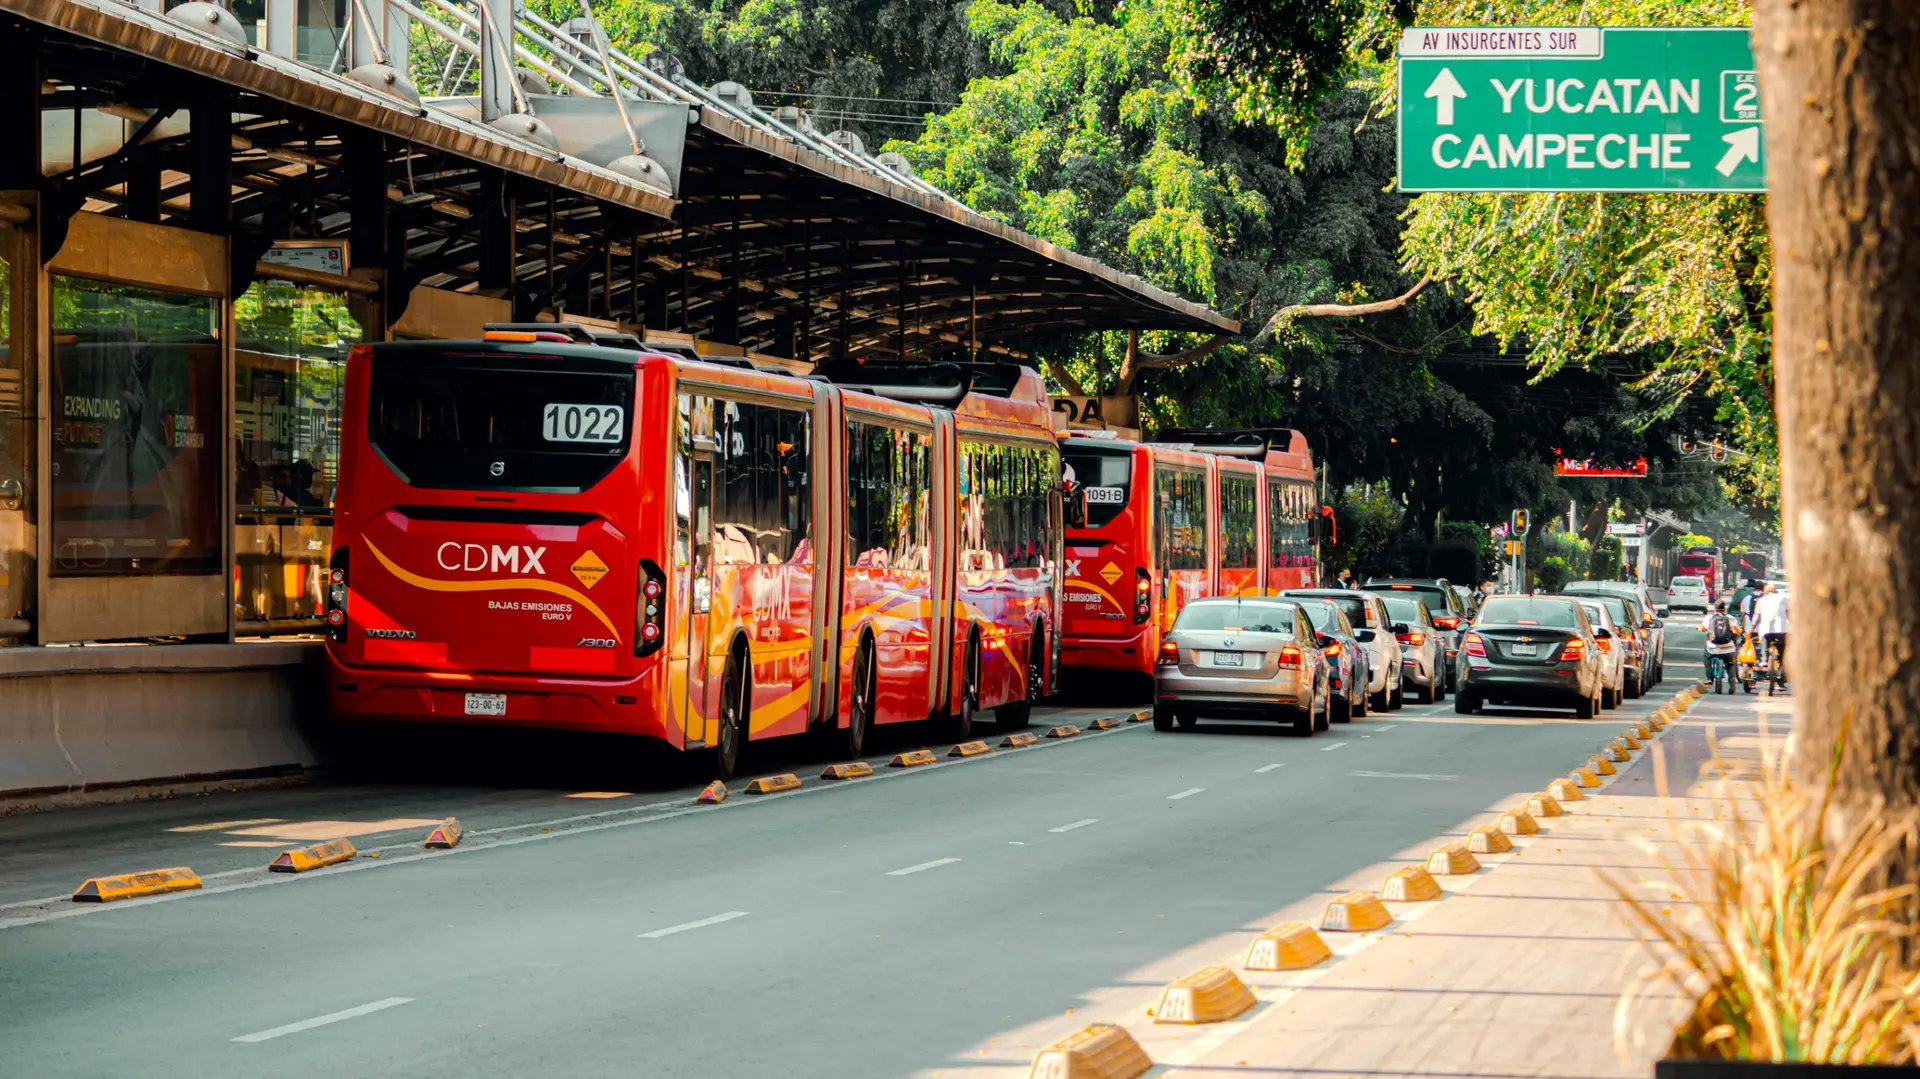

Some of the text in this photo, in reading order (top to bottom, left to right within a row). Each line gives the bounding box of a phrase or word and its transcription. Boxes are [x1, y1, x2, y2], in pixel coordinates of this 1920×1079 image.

[1422, 32, 1577, 50] AV INSURGENTES SUR
[1735, 74, 1756, 83] EJE
[1489, 78, 1700, 114] YUCATAN
[1734, 83, 1757, 111] 2
[1738, 111, 1757, 119] SUR
[1431, 133, 1691, 169] CAMPECHE
[64, 395, 121, 419] EXPANDING
[175, 414, 196, 431] GRUPO
[546, 405, 620, 440] 1022
[64, 421, 103, 444] FUTURE
[1086, 489, 1123, 501] 1091-B
[437, 541, 547, 575] CDMX
[1069, 592, 1102, 603] EMISIONES
[488, 600, 573, 612] BAJAS EMISIONES
[542, 612, 572, 621] EURO V
[365, 628, 417, 639] VOLVO
[576, 637, 616, 648] 7300
[467, 699, 505, 710] 123-00-63
